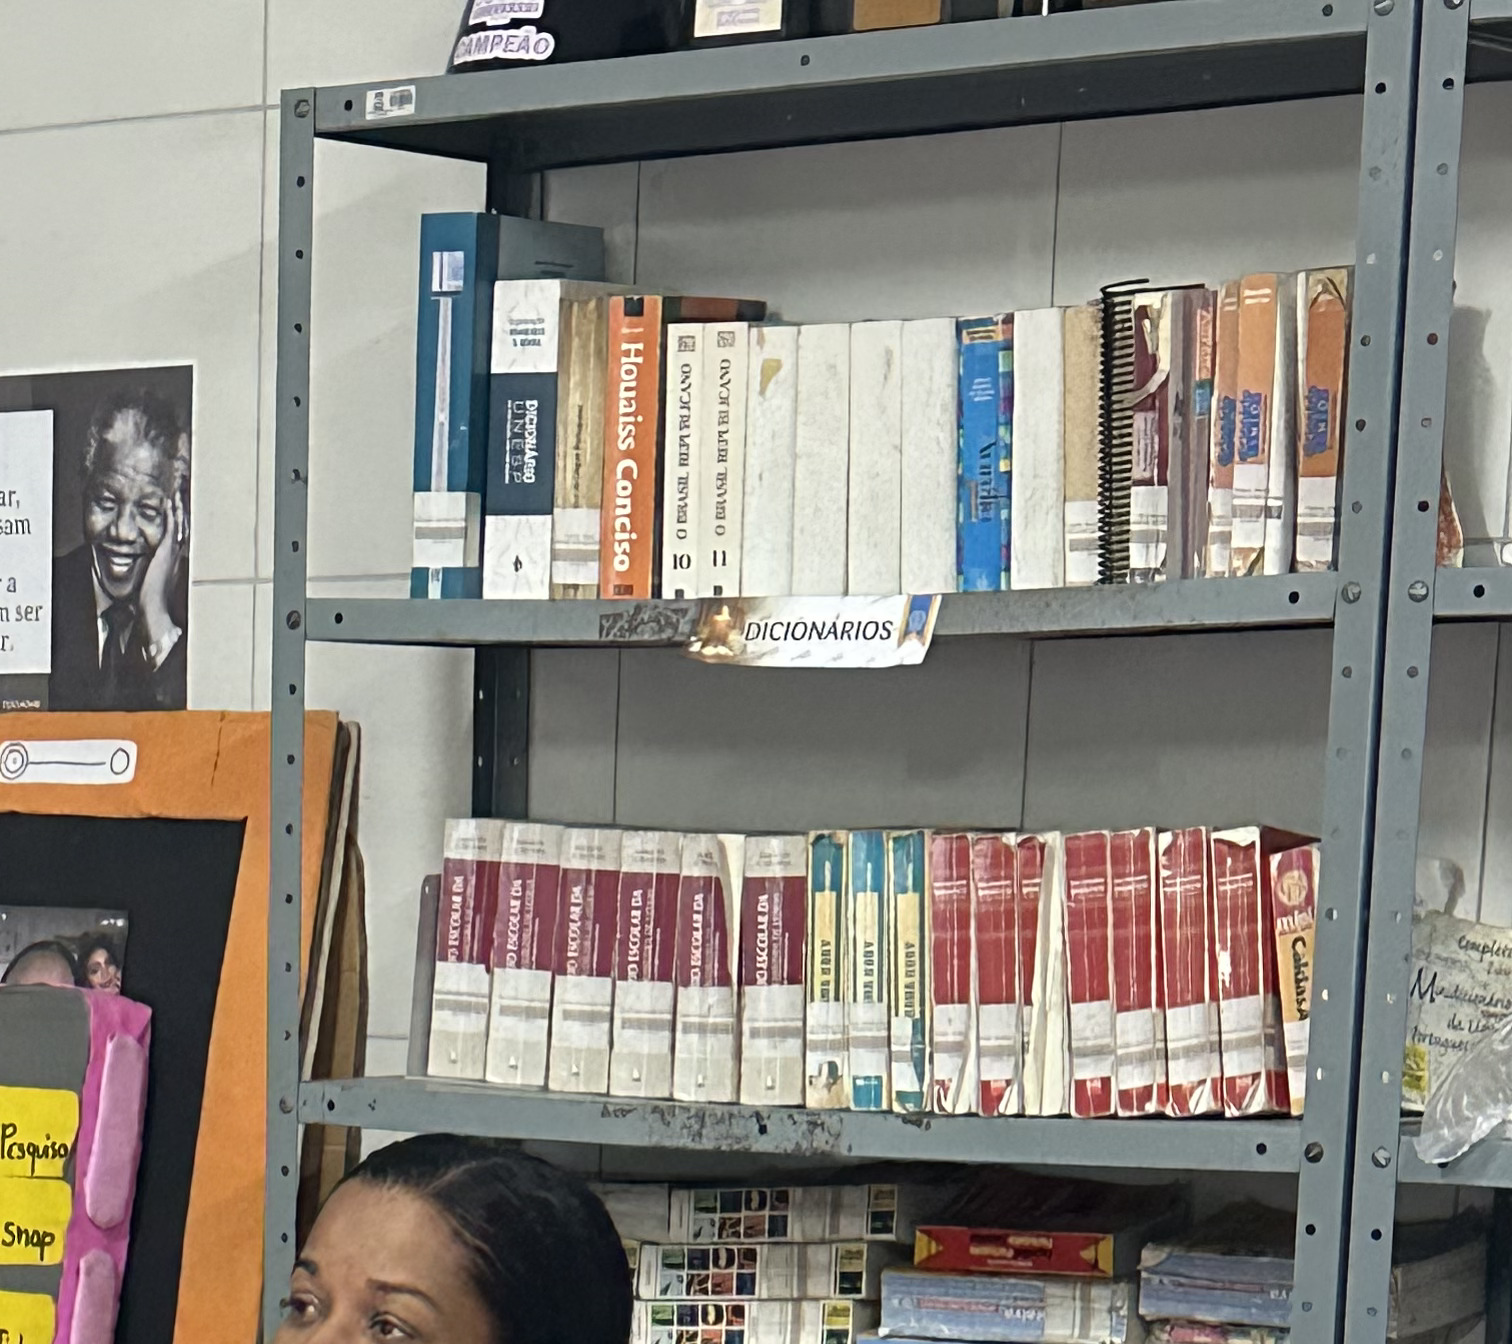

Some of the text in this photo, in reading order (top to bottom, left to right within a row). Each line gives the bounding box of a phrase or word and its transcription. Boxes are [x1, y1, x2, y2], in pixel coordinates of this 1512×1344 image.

[614, 340, 645, 573] Houaiss Conciso
[672, 553, 692, 571] 10
[711, 549, 727, 567] 11
[6, 575, 17, 594] a
[15, 604, 44, 622] ser
[744, 612, 894, 641] DICIONÁRIOS
[0, 1123, 70, 1177] Pesquisa
